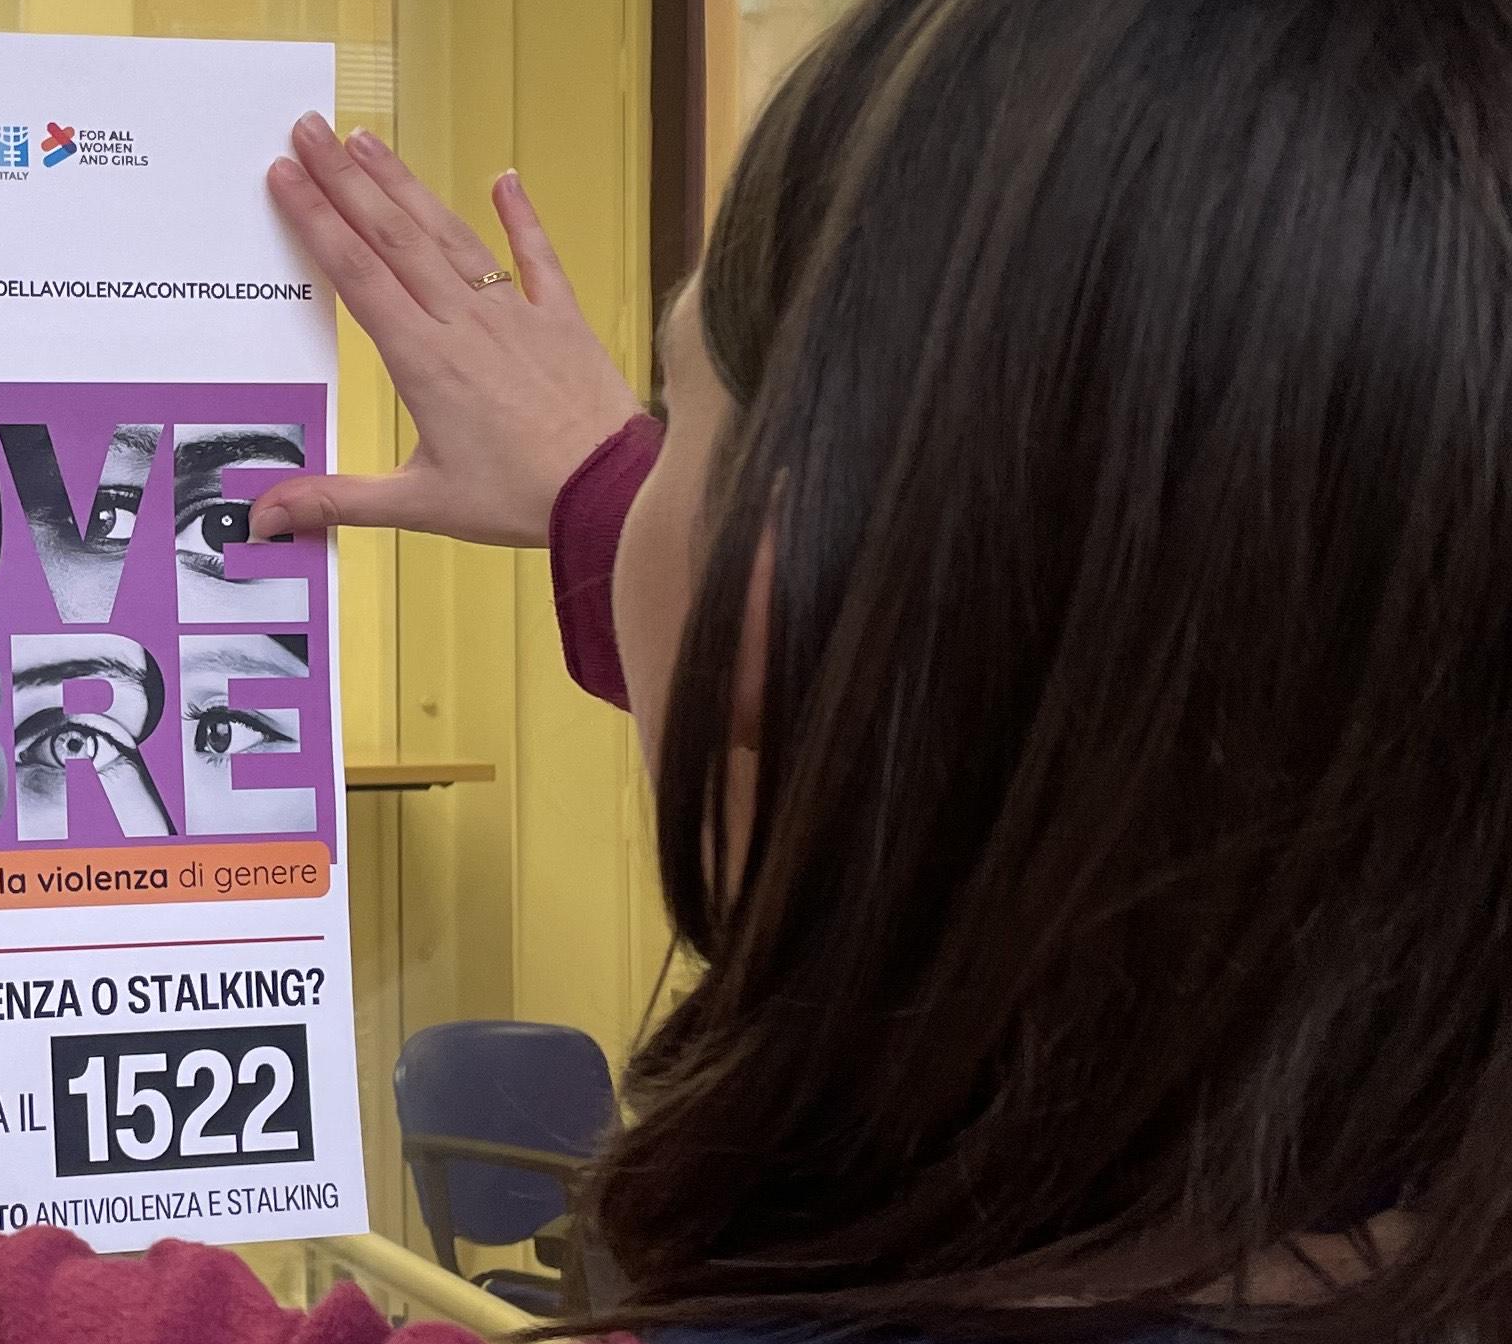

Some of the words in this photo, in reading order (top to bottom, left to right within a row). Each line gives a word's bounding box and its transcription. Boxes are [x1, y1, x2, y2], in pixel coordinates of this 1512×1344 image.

[79, 130, 106, 141] FOR
[109, 131, 134, 142] ALL
[80, 143, 133, 154] WOMEN
[79, 155, 108, 166] AND
[111, 155, 149, 167] GIRLS
[0, 171, 30, 182] ITALY
[38, 865, 168, 893] violenza
[179, 861, 204, 888] di
[214, 863, 318, 893] genere
[92, 976, 118, 1016] O
[128, 967, 326, 1014] STALKING?
[20, 1093, 47, 1132] IL
[68, 1045, 300, 1163] 1522
[36, 1192, 203, 1227] ANTIVIOLENZA
[208, 1189, 221, 1216] E
[227, 1182, 339, 1215] STALKING
